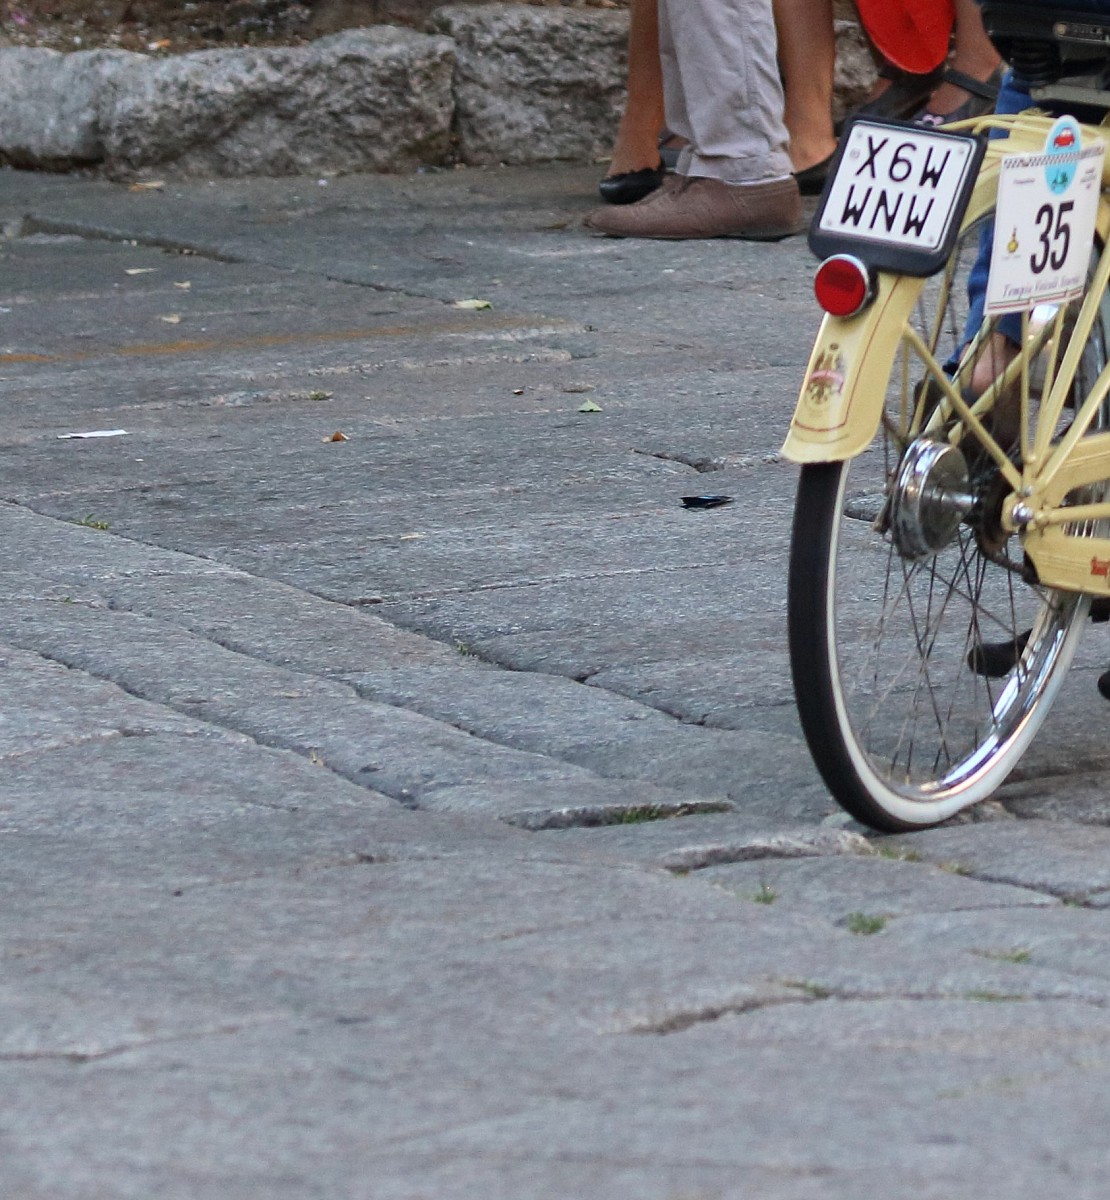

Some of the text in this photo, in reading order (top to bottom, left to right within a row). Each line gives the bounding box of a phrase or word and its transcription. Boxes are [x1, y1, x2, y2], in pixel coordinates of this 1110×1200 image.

[855, 135, 952, 189] X6W
[840, 183, 936, 237] WNW
[1030, 201, 1075, 274] 35
